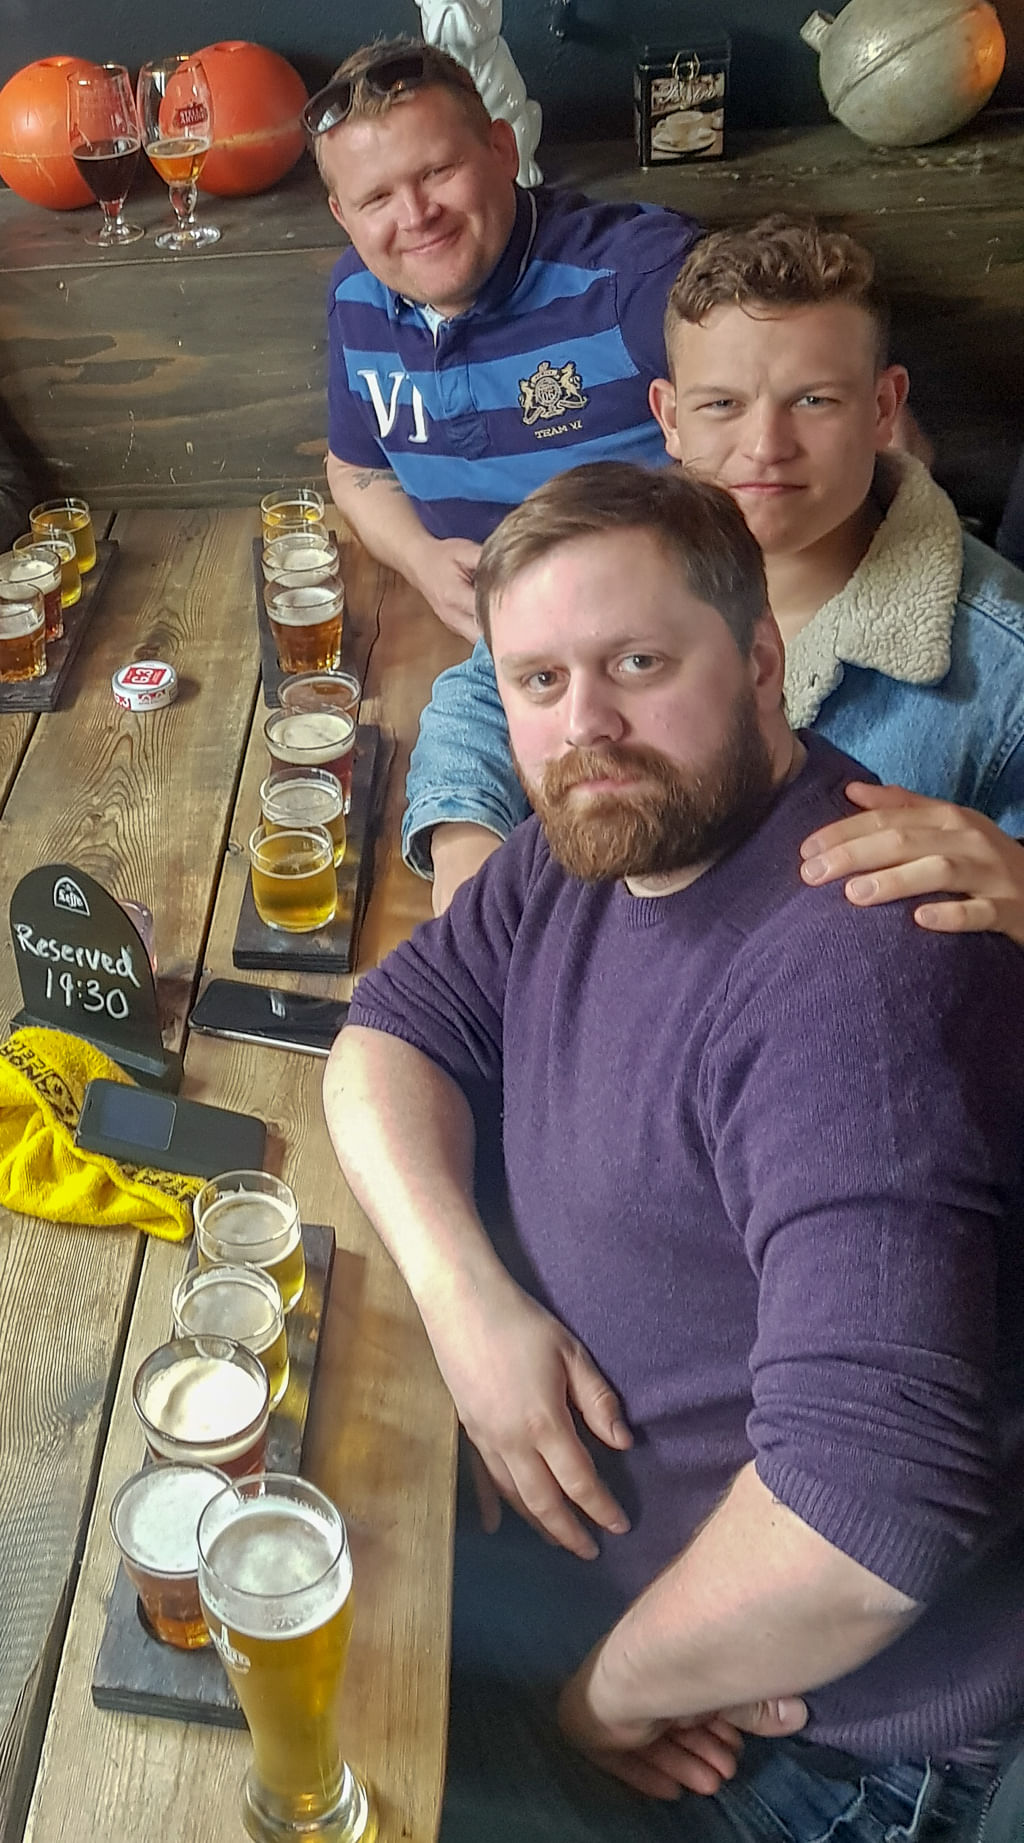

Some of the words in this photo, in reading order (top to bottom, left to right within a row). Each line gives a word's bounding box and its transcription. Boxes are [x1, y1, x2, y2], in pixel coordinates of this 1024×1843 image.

[357, 368, 428, 444] VI
[534, 424, 568, 439] TEAM
[569, 419, 583, 430] VI
[14, 923, 141, 988] Reserved
[46, 968, 129, 1019] 19:30
